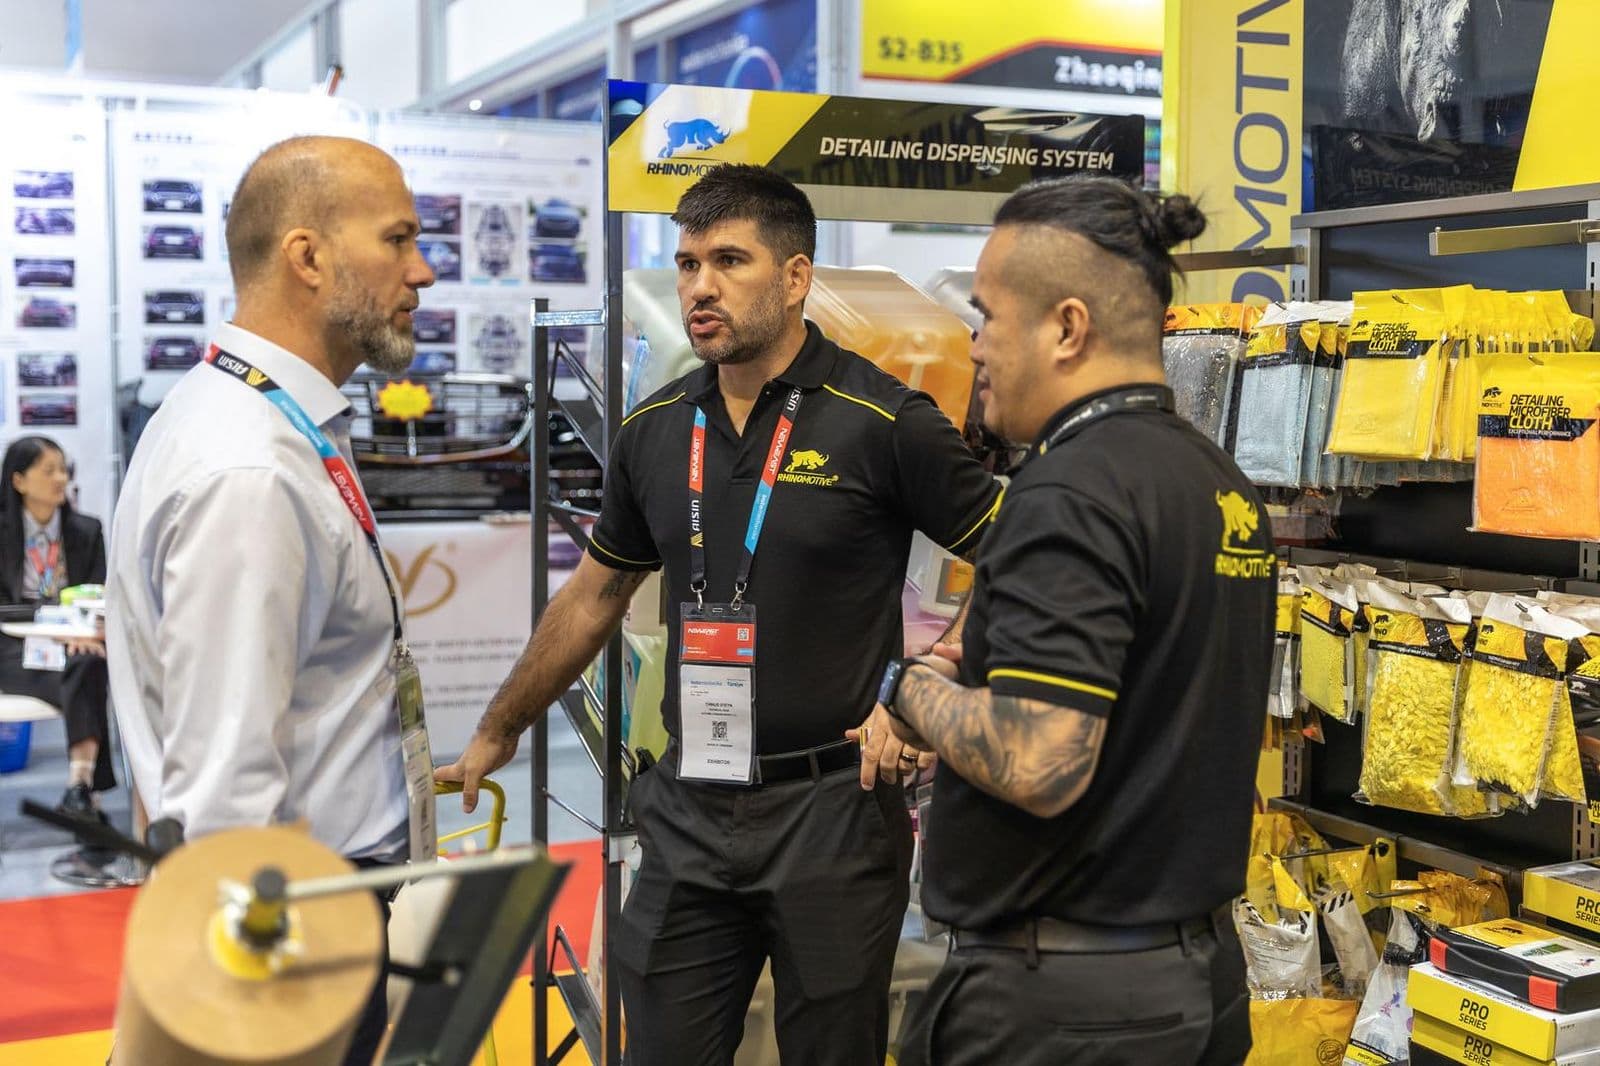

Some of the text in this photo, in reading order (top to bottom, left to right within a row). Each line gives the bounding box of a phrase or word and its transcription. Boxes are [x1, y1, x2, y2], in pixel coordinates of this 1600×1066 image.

[1055, 56, 1162, 94] Zhaoqin
[820, 136, 1114, 170] DETAILING DISPENSING SYSTEM
[1370, 330, 1418, 341] MICROFIBER
[1368, 340, 1399, 351] CLOTH
[1510, 394, 1564, 406] DETAILING
[1509, 405, 1571, 418] MICROFIBER
[1509, 417, 1553, 430] CLOTH
[1576, 910, 1600, 926] SERIE
[1460, 998, 1490, 1020] PRO
[1459, 1012, 1487, 1031] SERIES
[1464, 1035, 1493, 1057] PRO
[1463, 1049, 1491, 1066] SERIES
